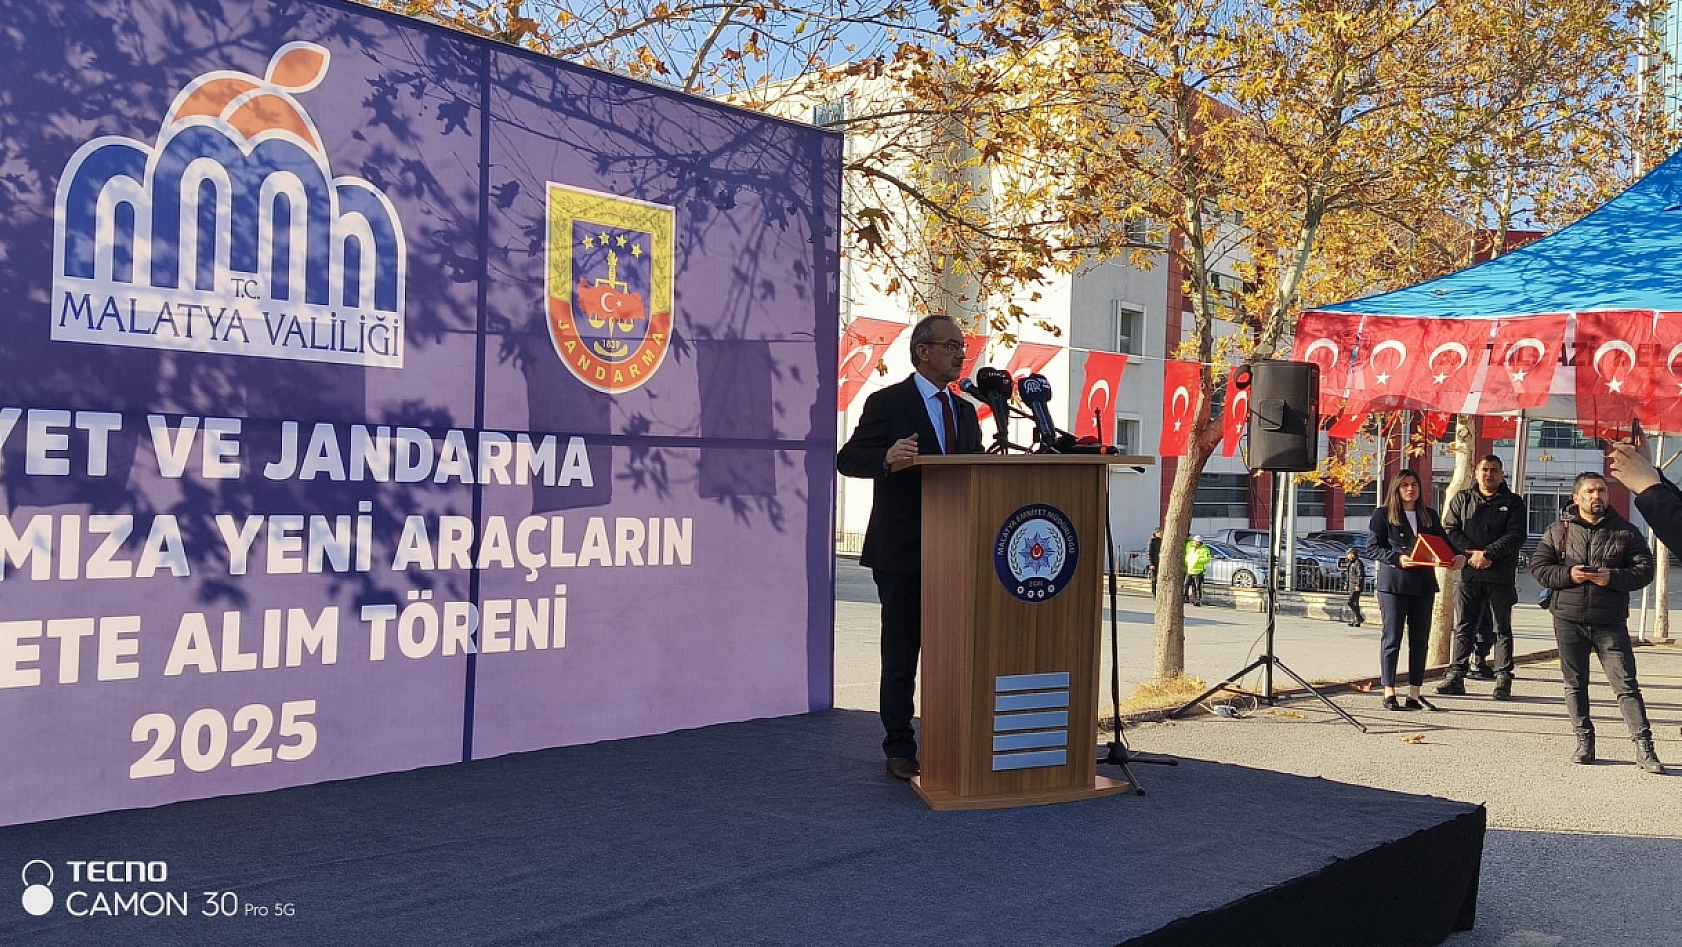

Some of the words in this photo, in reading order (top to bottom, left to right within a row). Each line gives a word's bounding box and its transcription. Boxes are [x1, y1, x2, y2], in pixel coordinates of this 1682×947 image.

[59, 290, 250, 343] MALATYA
[263, 312, 399, 357] VALİLİĞİ
[230, 278, 261, 300] T.C.
[558, 319, 664, 383] JANDARMA
[147, 415, 242, 479] VE
[263, 421, 594, 487] JANDARMA
[0, 514, 190, 581] MIZA
[215, 501, 372, 575] YENİ
[391, 514, 692, 582] ARAÇLARIN
[997, 520, 1018, 556] MALATYA
[0, 615, 141, 688] ETE
[163, 606, 339, 676] ALIM
[361, 584, 567, 661] TÖRENİ
[129, 699, 317, 779] 2025
